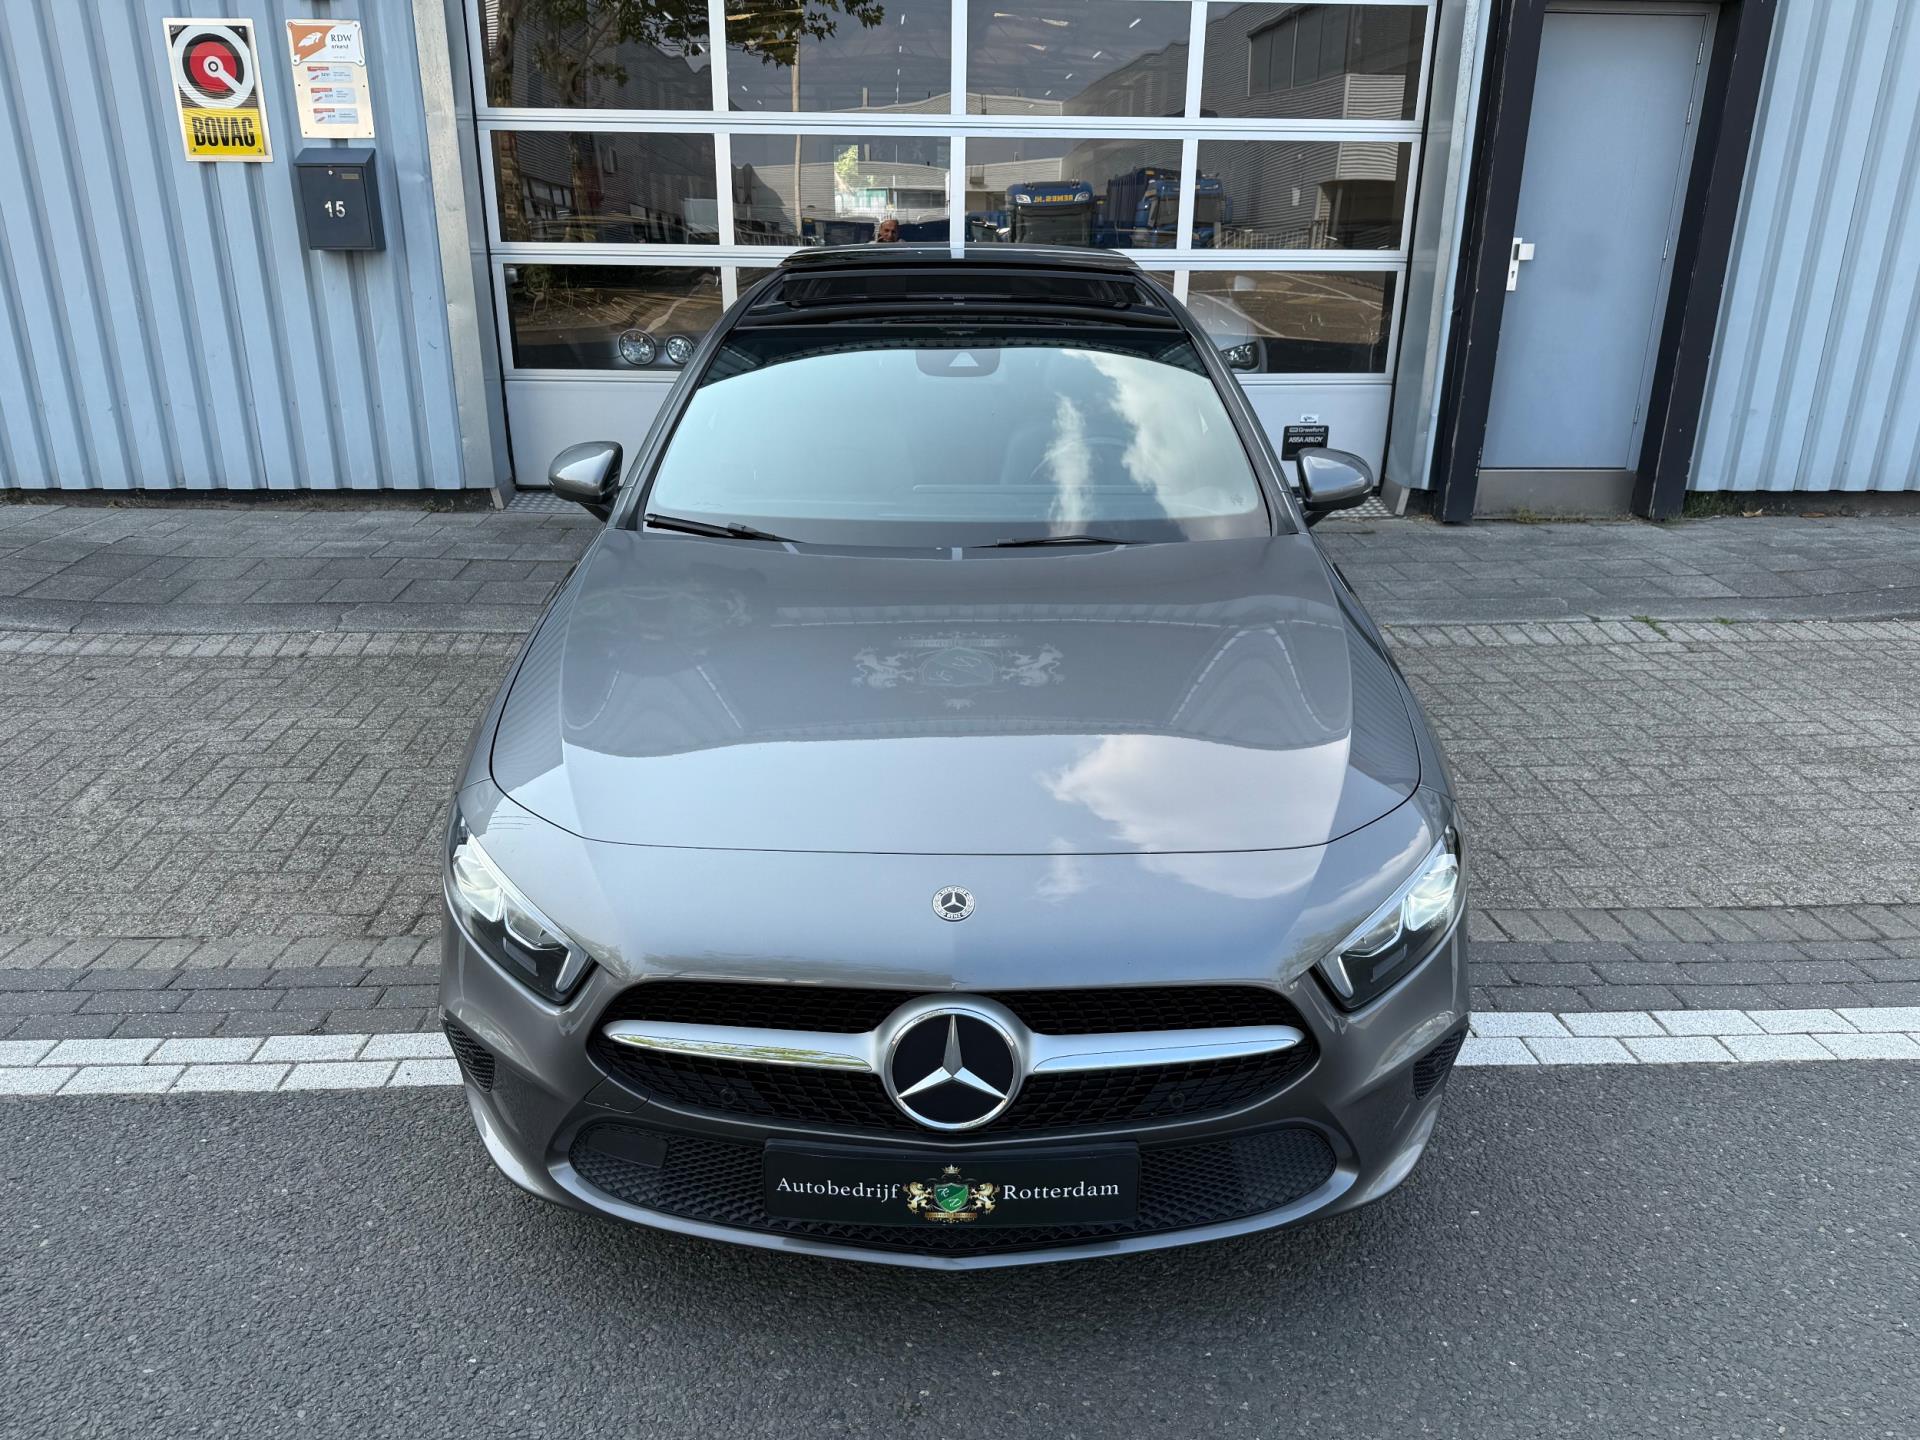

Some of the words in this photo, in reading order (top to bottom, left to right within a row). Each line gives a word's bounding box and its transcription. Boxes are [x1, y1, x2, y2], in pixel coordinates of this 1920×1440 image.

[330, 34, 352, 42] RDW
[191, 116, 256, 147] BOVAG
[324, 200, 346, 218] 15
[776, 1177, 901, 1203] Autobedrijf
[1002, 1181, 1120, 1200] Rotterdam
